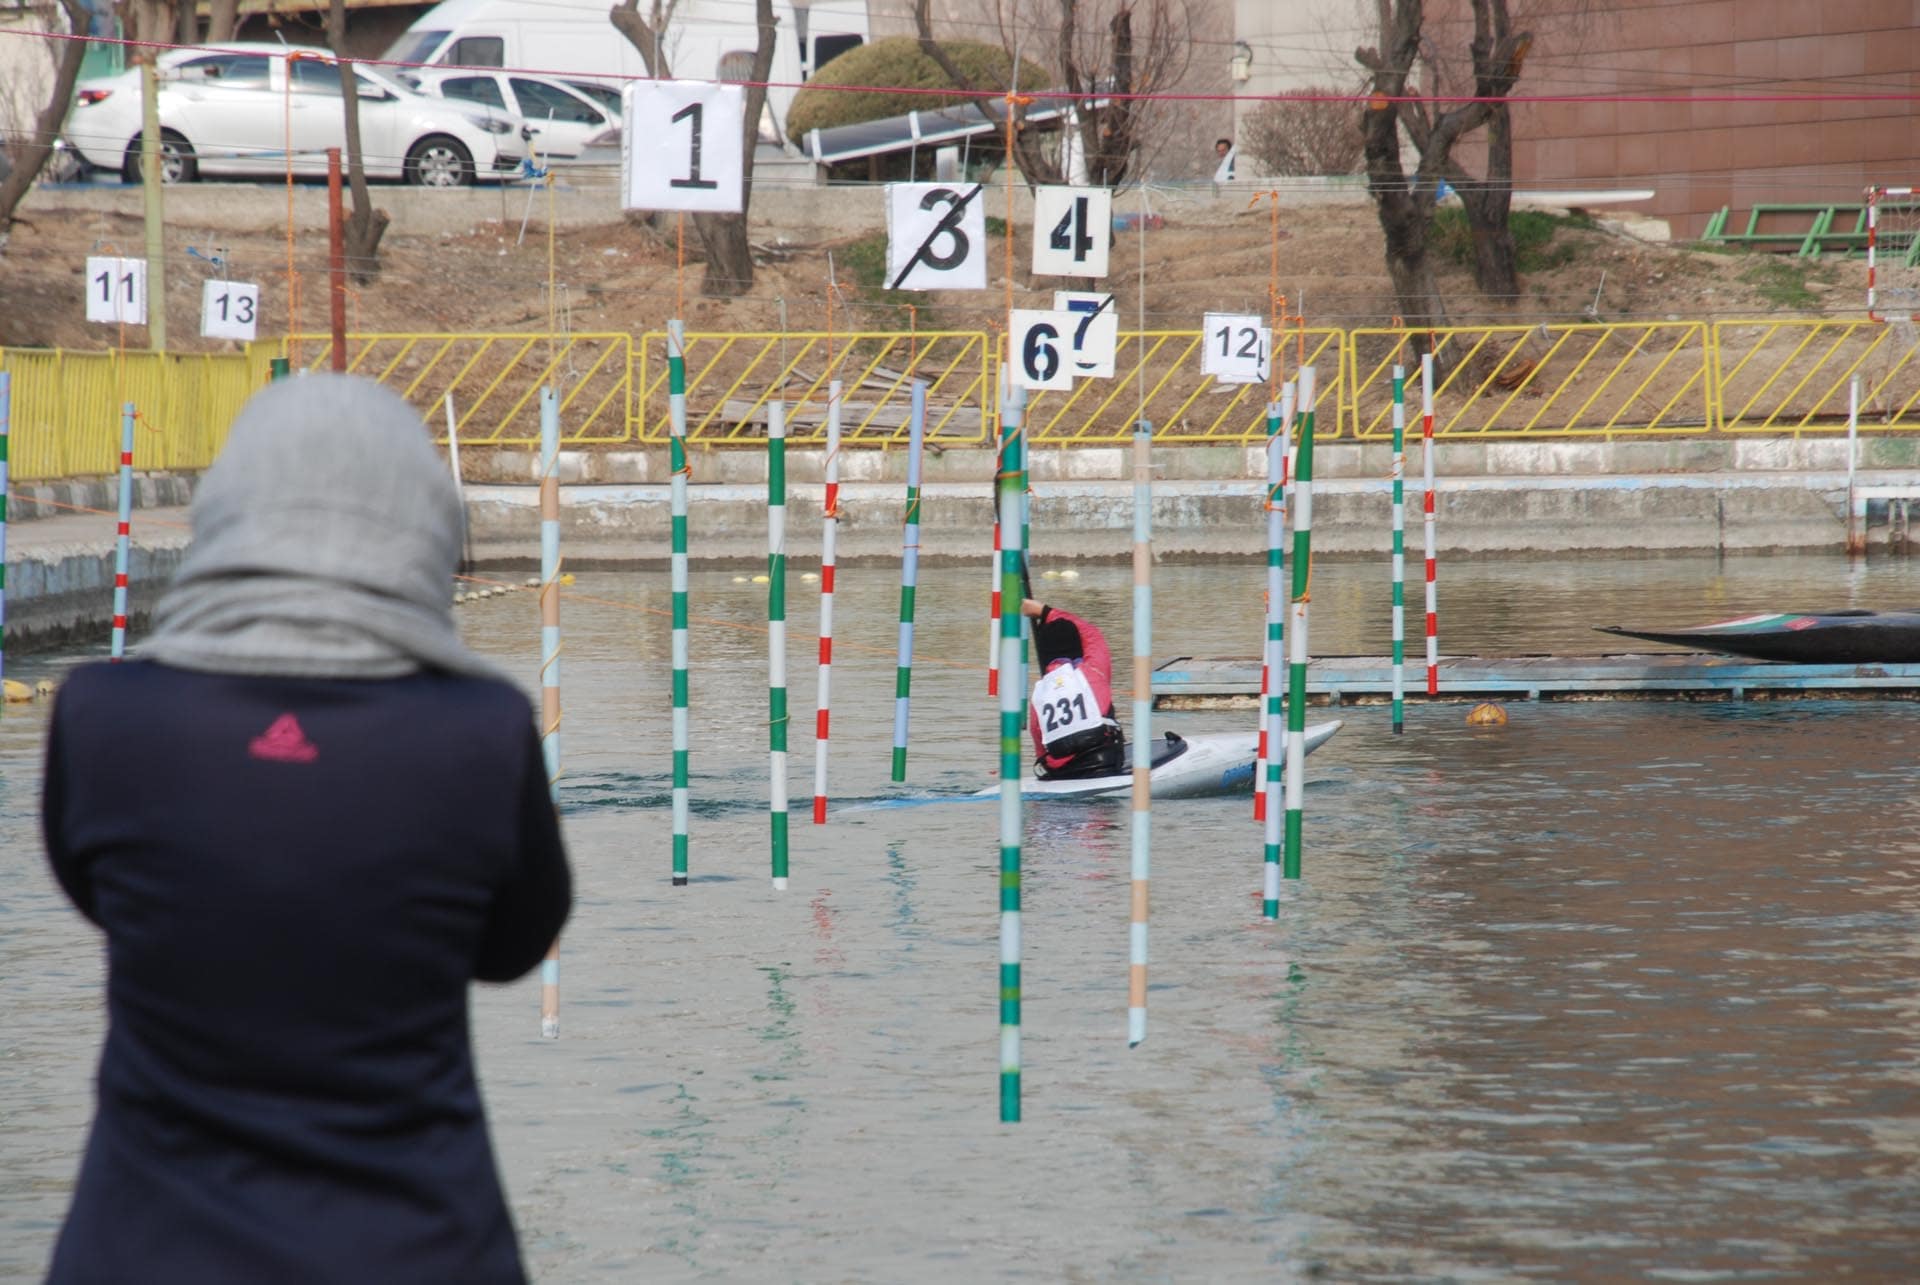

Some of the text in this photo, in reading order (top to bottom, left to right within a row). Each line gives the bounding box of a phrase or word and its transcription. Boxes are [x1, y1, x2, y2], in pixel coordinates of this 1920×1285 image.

[670, 102, 718, 190] 1
[919, 188, 969, 271] 3
[1050, 197, 1093, 262] 4
[95, 271, 133, 303] 11
[215, 293, 254, 323] 13
[1023, 323, 1059, 381] 6
[1216, 326, 1258, 358] 12
[1043, 693, 1087, 732] 231
